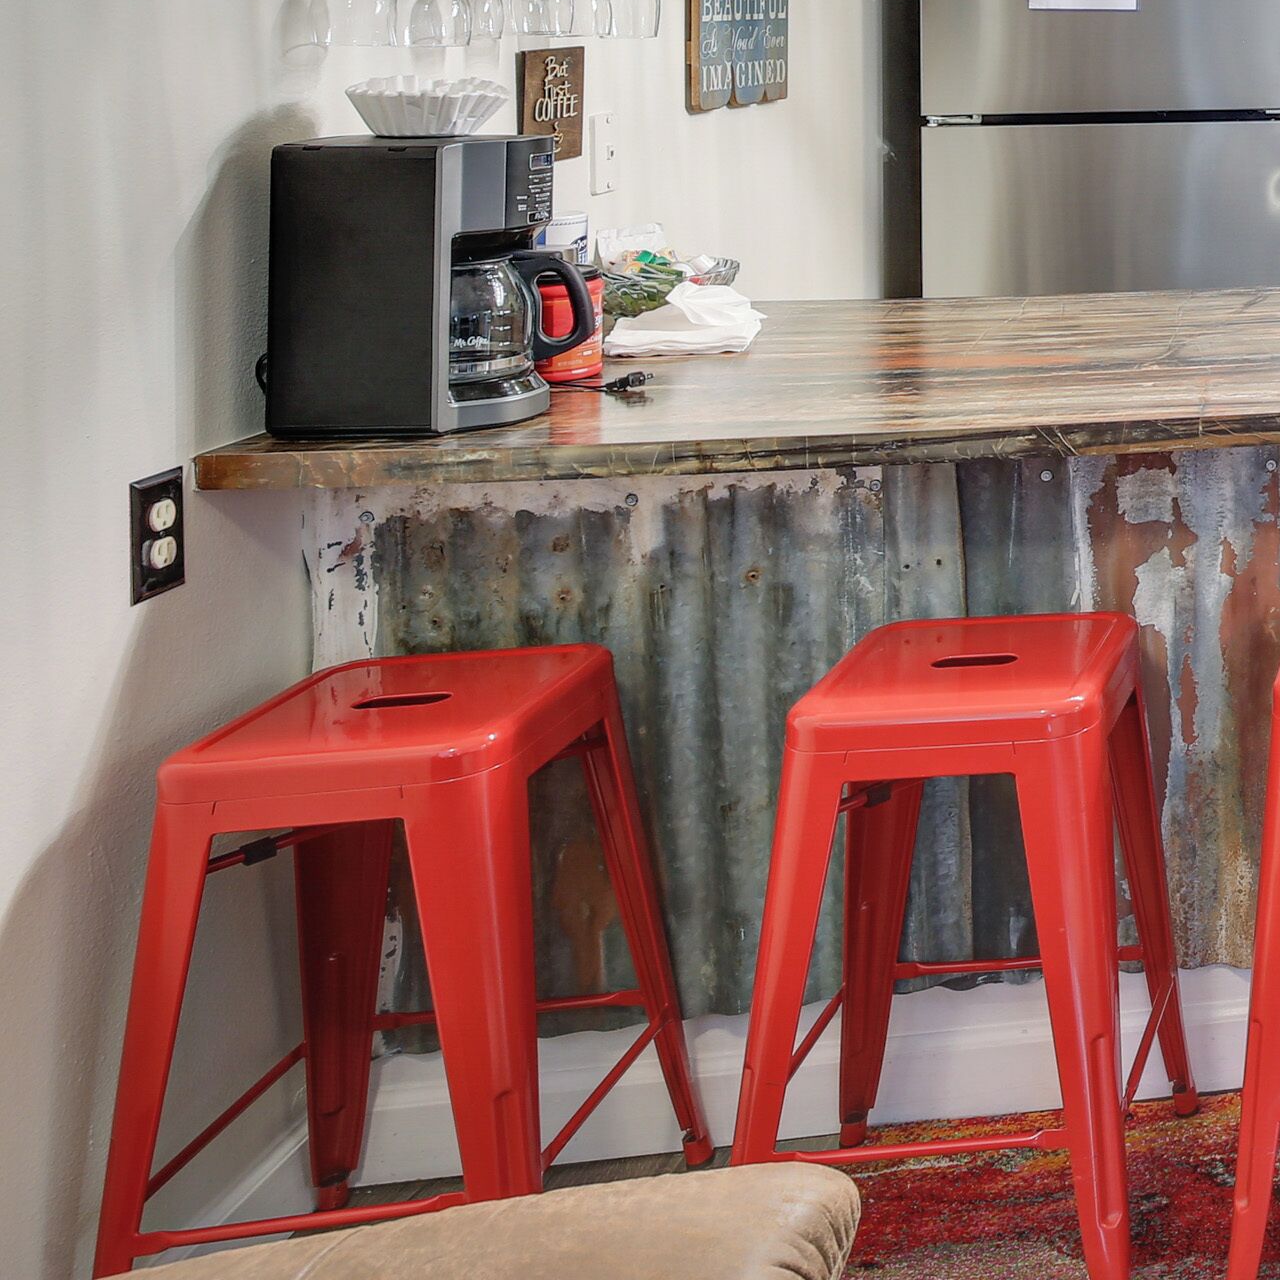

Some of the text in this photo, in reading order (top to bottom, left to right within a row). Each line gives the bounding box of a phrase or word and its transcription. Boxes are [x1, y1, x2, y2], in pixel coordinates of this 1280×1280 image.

[545, 56, 568, 80] But
[702, 58, 786, 92] IMAGINED
[535, 94, 579, 121] COFFEE
